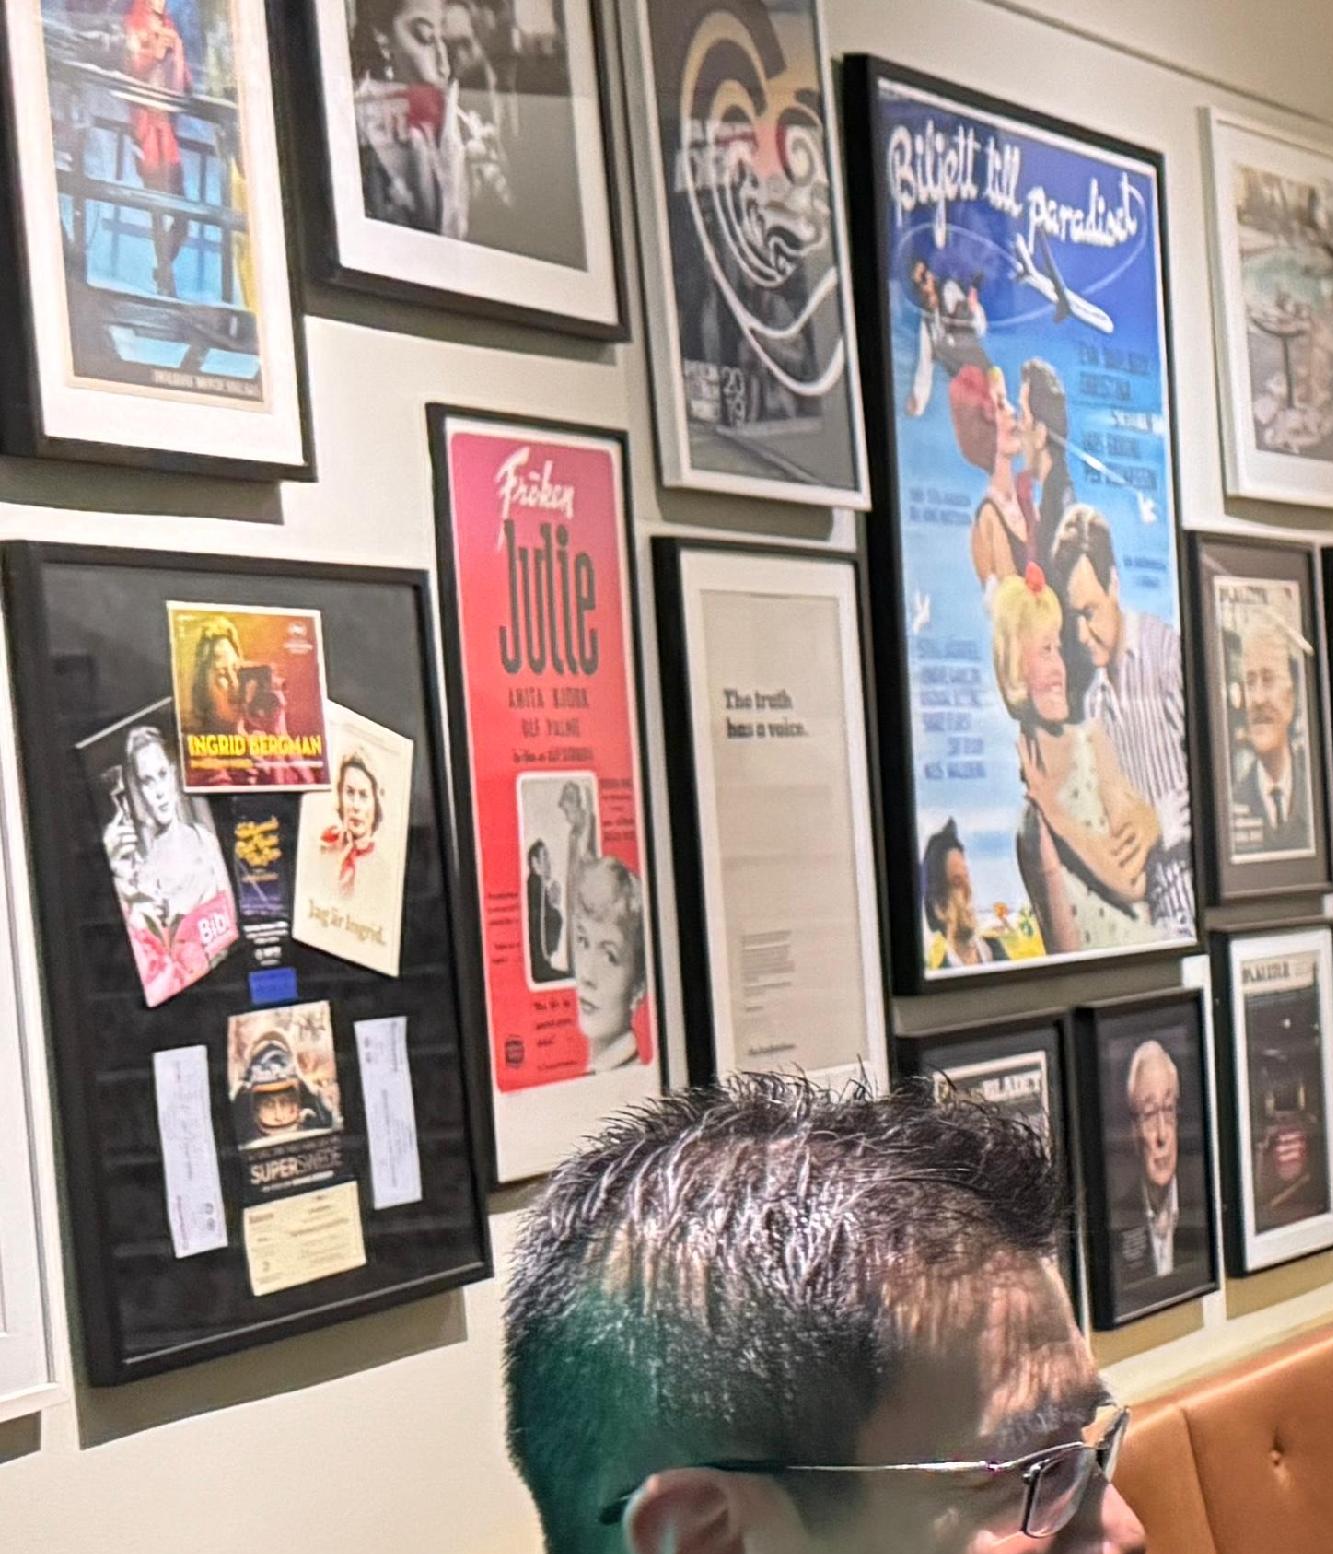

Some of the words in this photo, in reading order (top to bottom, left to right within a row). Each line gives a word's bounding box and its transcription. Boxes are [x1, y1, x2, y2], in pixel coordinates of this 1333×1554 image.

[888, 120, 981, 249] Biljett
[985, 137, 1022, 218] till
[1027, 172, 1143, 253] paradiset
[499, 518, 600, 678] Julie
[723, 688, 752, 710] The
[754, 689, 793, 711] truth
[726, 718, 753, 740] has
[756, 723, 766, 739] a
[187, 734, 247, 757] INGRID
[249, 734, 322, 757] BERGMAN
